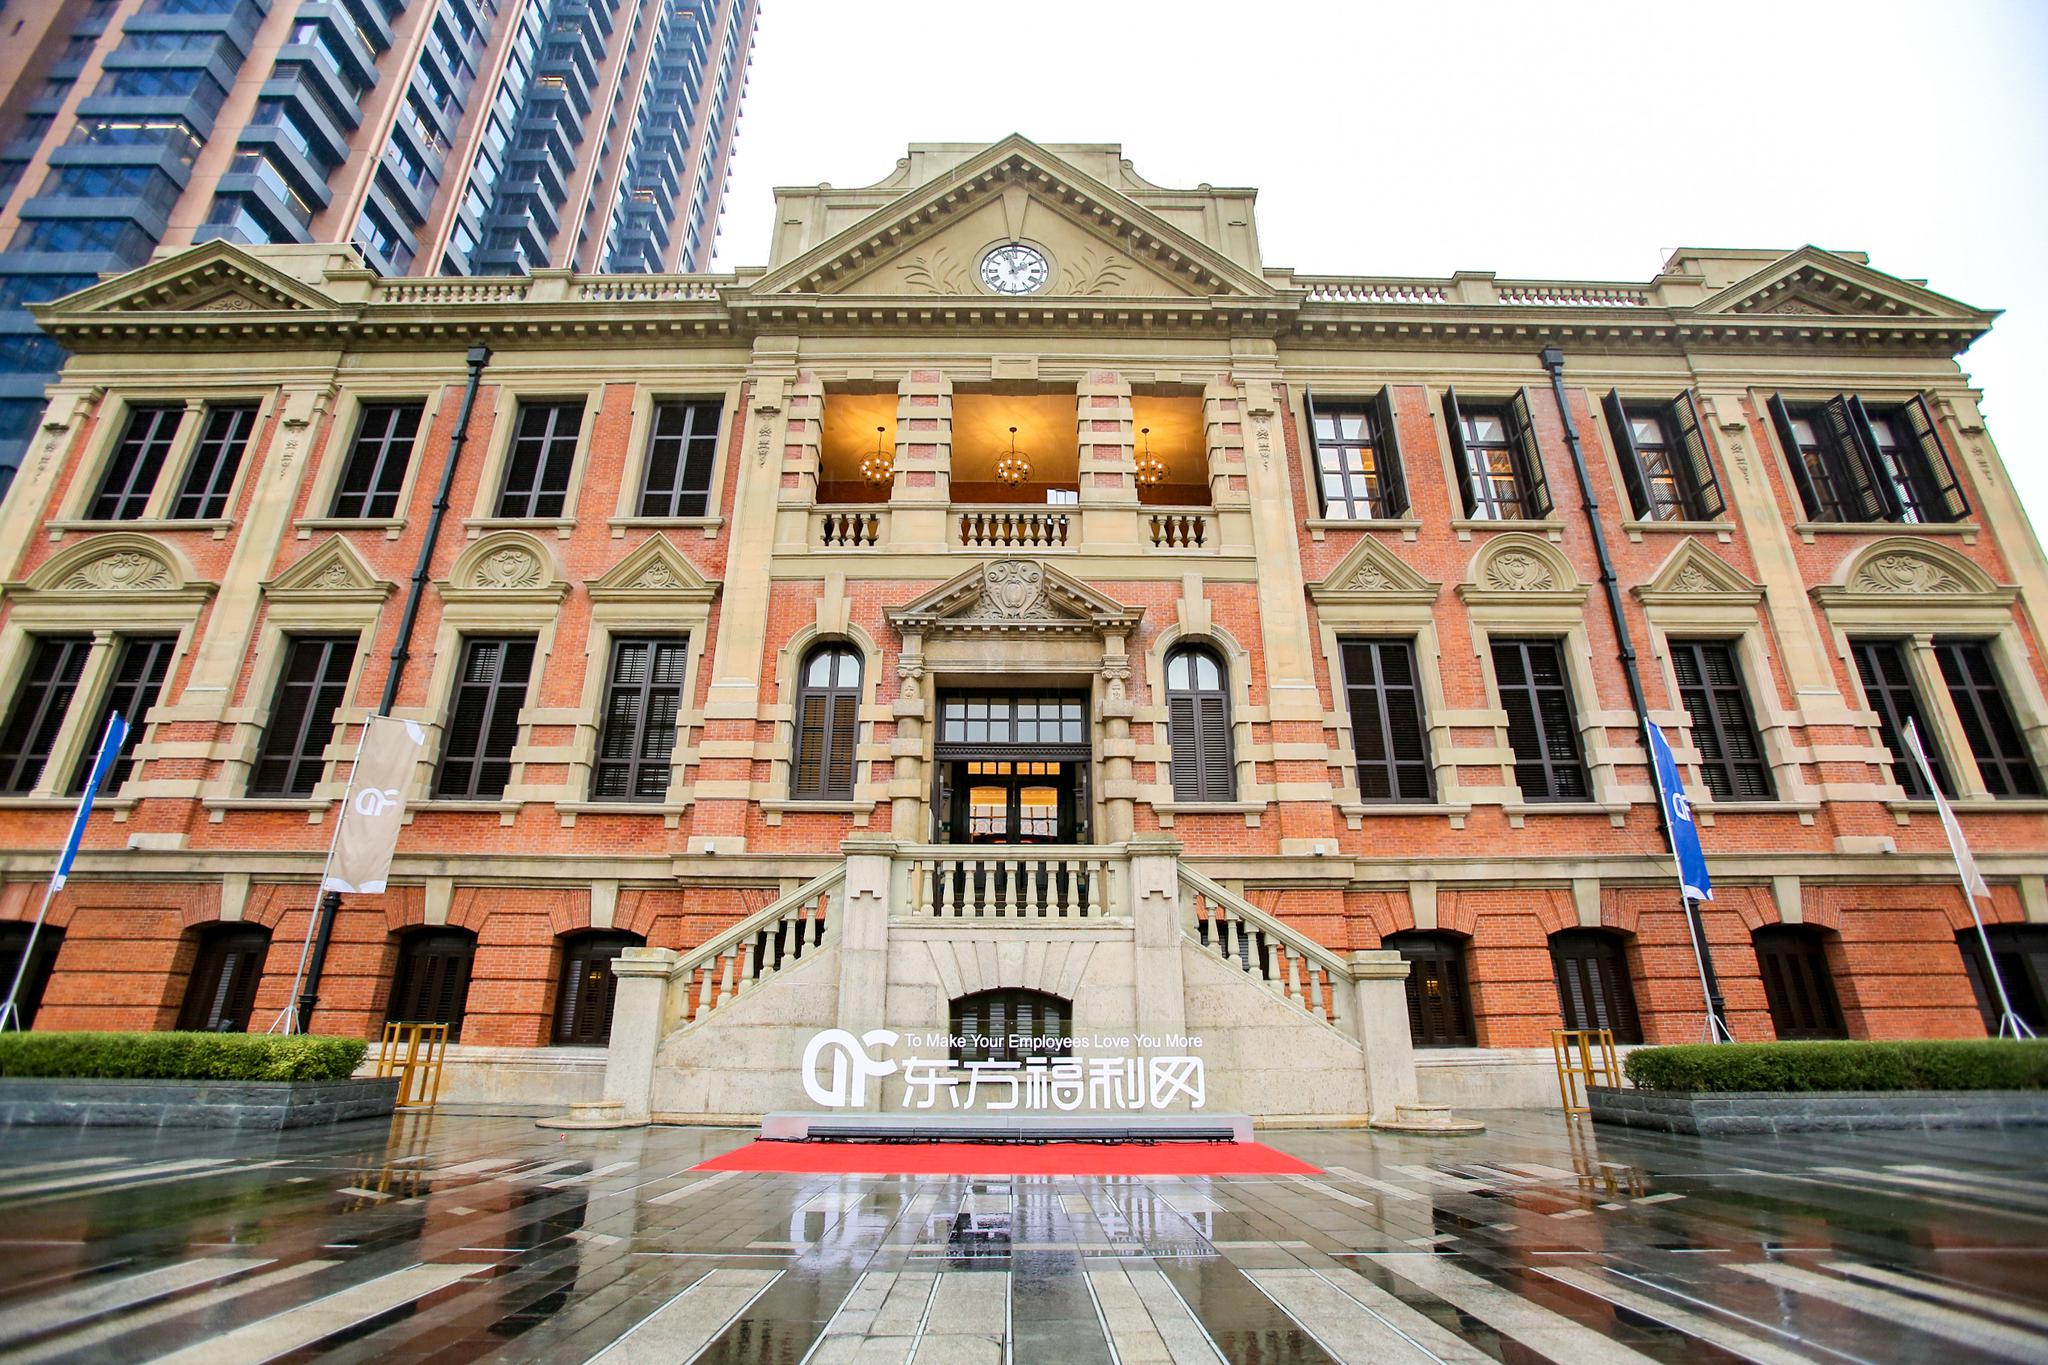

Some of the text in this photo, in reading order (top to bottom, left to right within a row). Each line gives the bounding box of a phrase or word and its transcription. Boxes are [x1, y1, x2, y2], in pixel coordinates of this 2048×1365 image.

[904, 1033, 1203, 1051] To Make Your Employees Love You More
[902, 1056, 1205, 1110] 东方福利网
